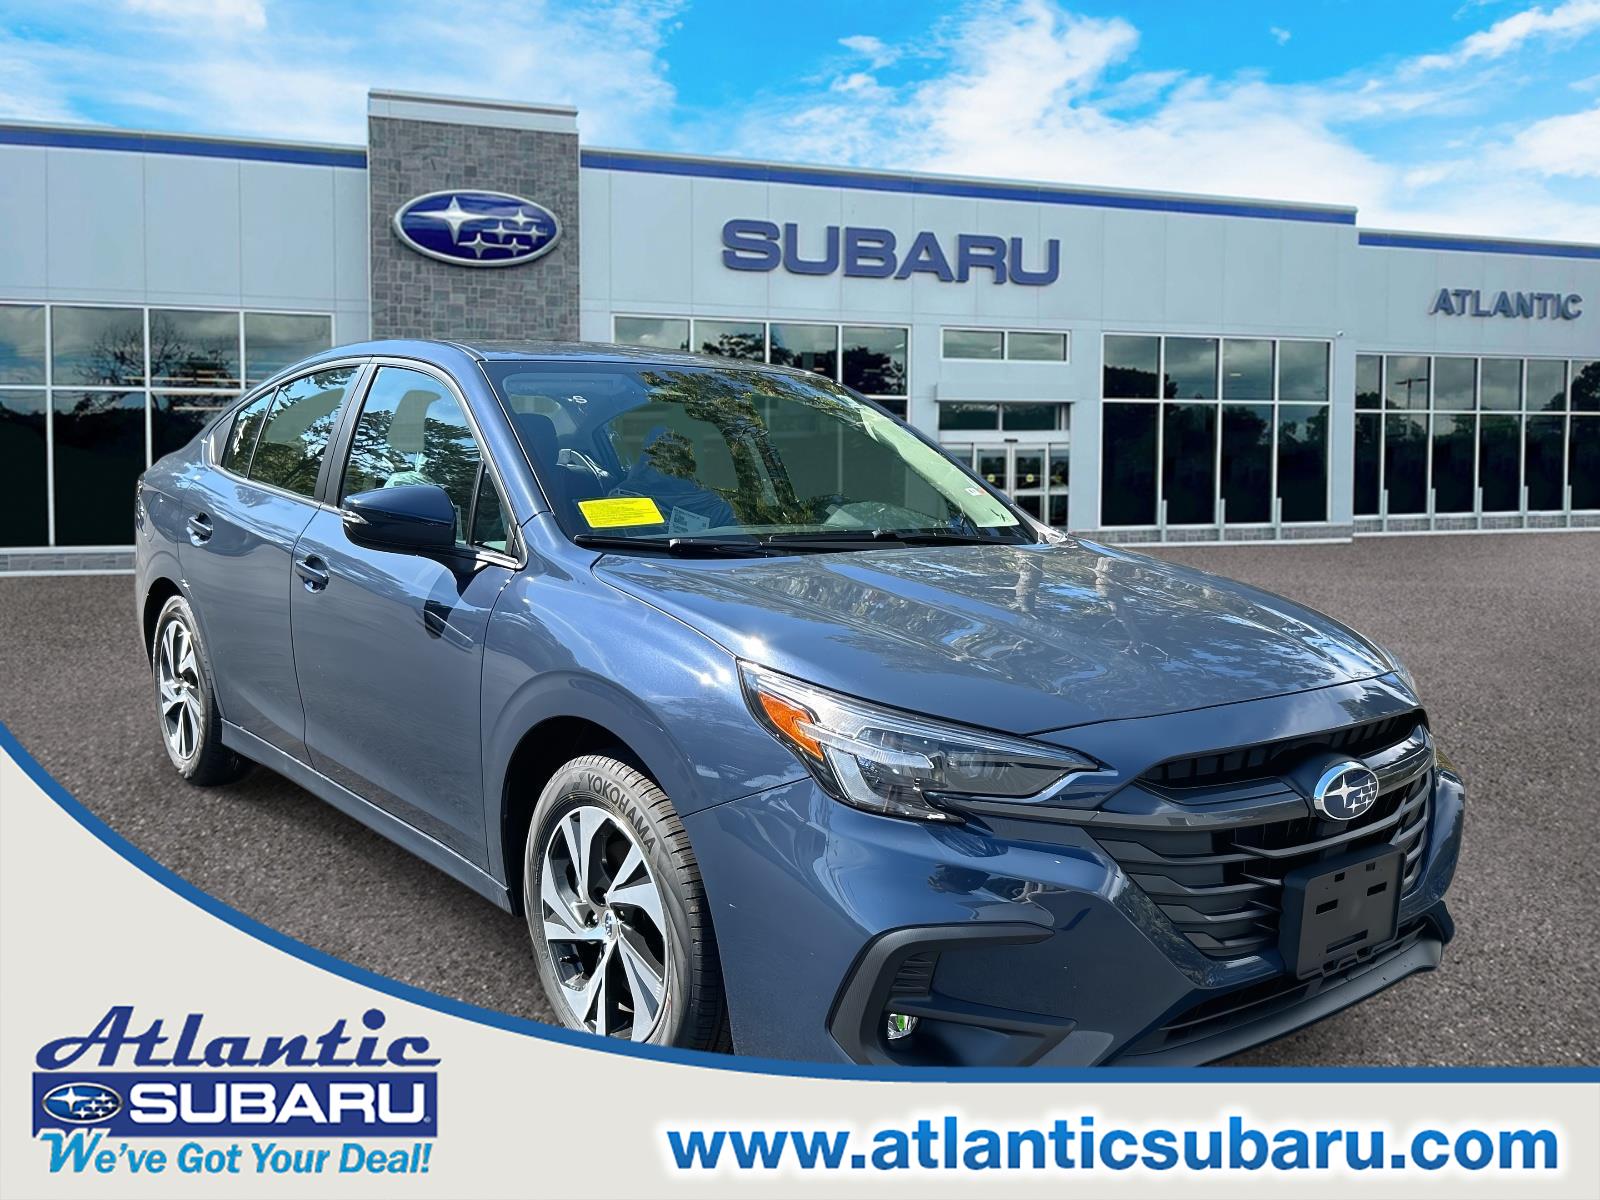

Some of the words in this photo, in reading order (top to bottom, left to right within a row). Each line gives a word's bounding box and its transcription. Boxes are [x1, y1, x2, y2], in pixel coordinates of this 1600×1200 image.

[722, 219, 1060, 286] SUBARU
[1430, 288, 1583, 321] ATLANTIC
[587, 773, 656, 853] YOKOHAMA
